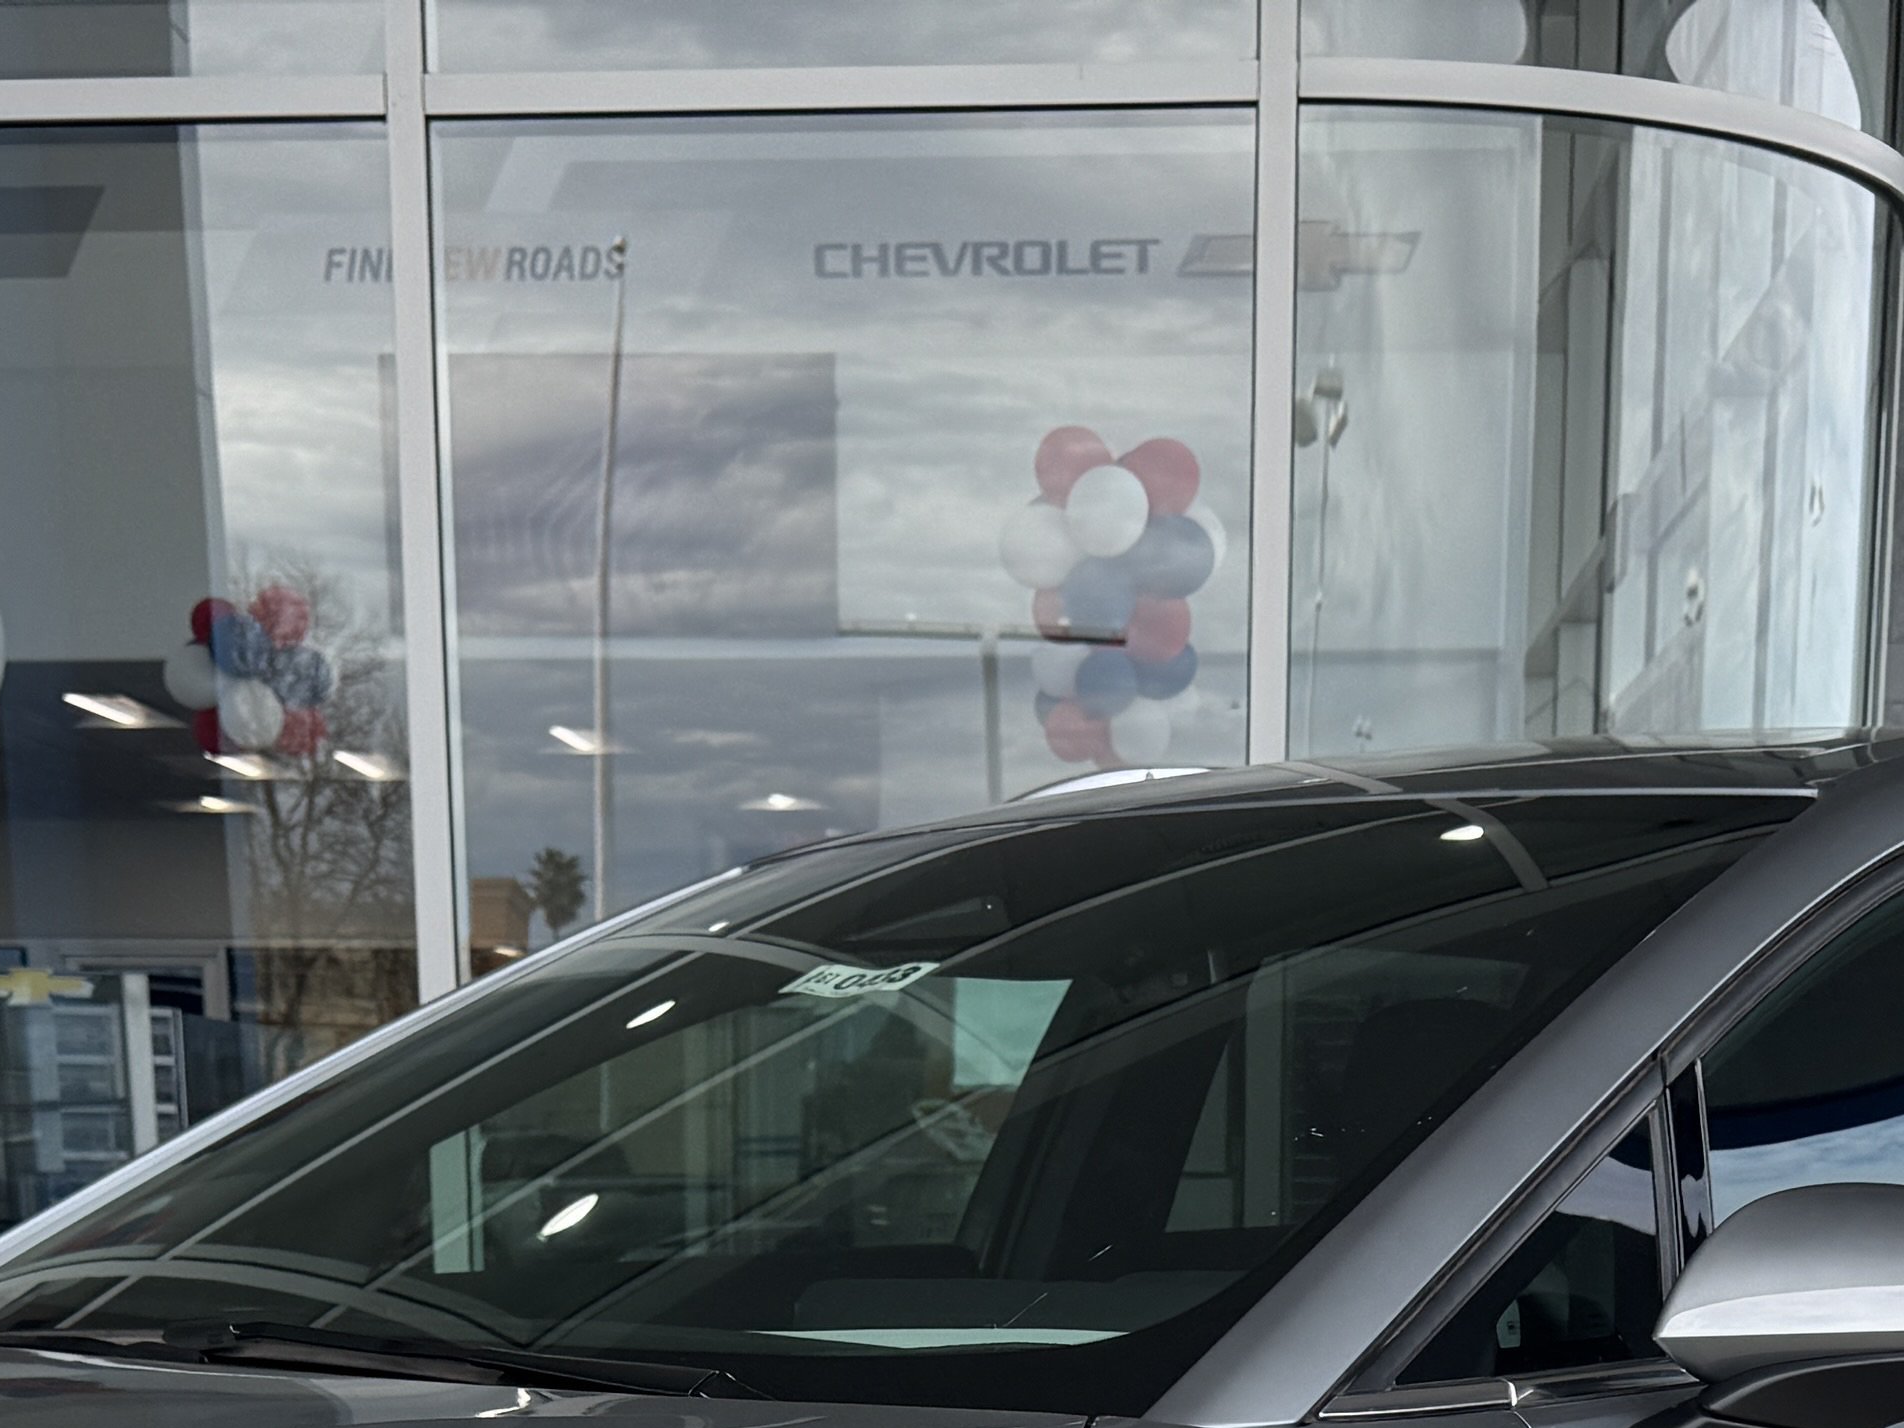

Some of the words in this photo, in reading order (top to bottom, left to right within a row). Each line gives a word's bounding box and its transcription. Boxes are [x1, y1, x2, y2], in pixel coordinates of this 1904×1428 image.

[324, 247, 393, 283] FIN
[445, 247, 502, 282] EW
[504, 246, 626, 282] ROADS
[813, 238, 1161, 280] CHEVROLET
